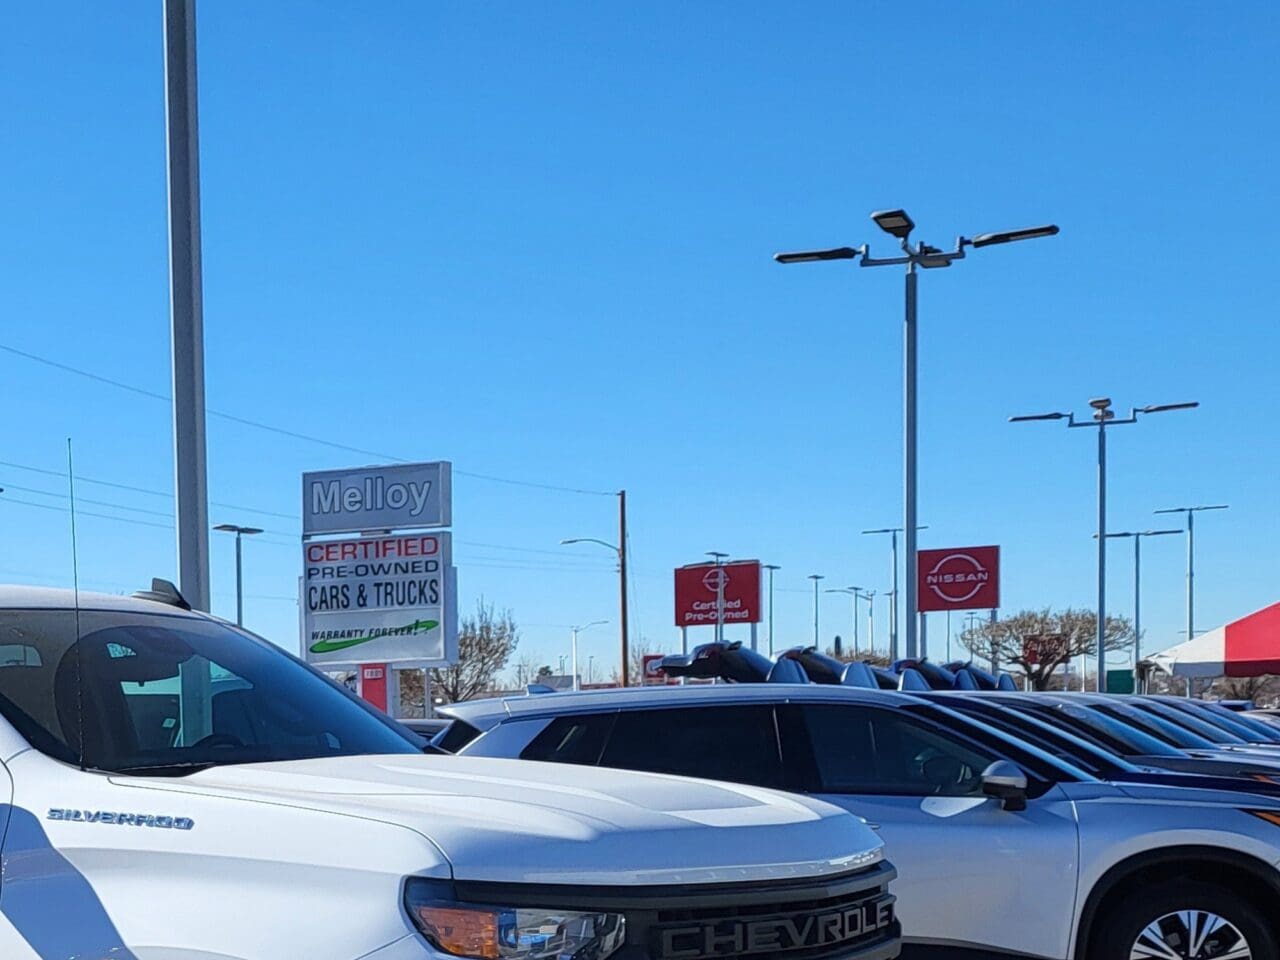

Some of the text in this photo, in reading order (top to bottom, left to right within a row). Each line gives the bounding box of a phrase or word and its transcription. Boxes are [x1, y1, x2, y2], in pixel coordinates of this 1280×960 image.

[312, 477, 432, 516] Melloy
[307, 537, 439, 563] CERTIFIED
[307, 560, 439, 580] PRE-OWNED
[926, 571, 989, 584] NISSAN
[308, 579, 439, 611] CARS & TRUCKS
[312, 619, 420, 640] WARRANTY FOREVER!
[46, 808, 195, 831] SILVERADO
[662, 900, 896, 957] CHEVROLE
